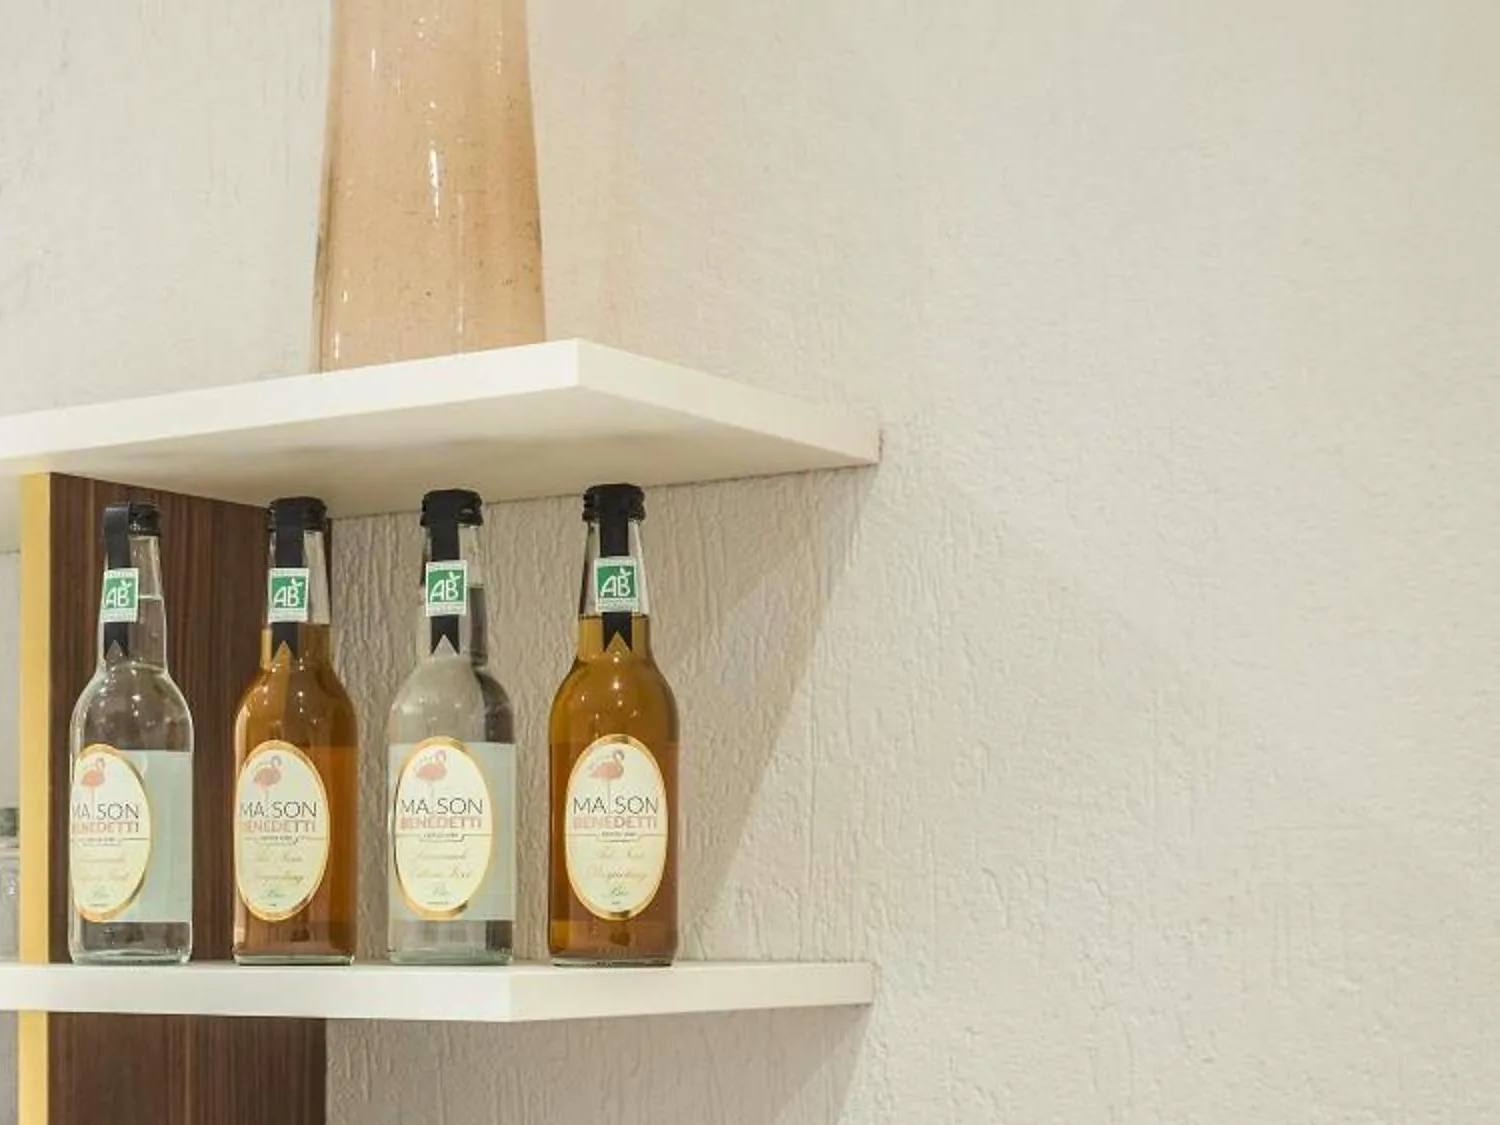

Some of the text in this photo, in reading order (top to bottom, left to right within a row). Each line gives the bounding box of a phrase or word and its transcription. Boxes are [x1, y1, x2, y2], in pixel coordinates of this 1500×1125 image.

[105, 585, 130, 607] AB
[273, 585, 300, 607] AB
[429, 579, 459, 601] AB
[601, 575, 631, 597] AB
[573, 796, 659, 815] MAISON
